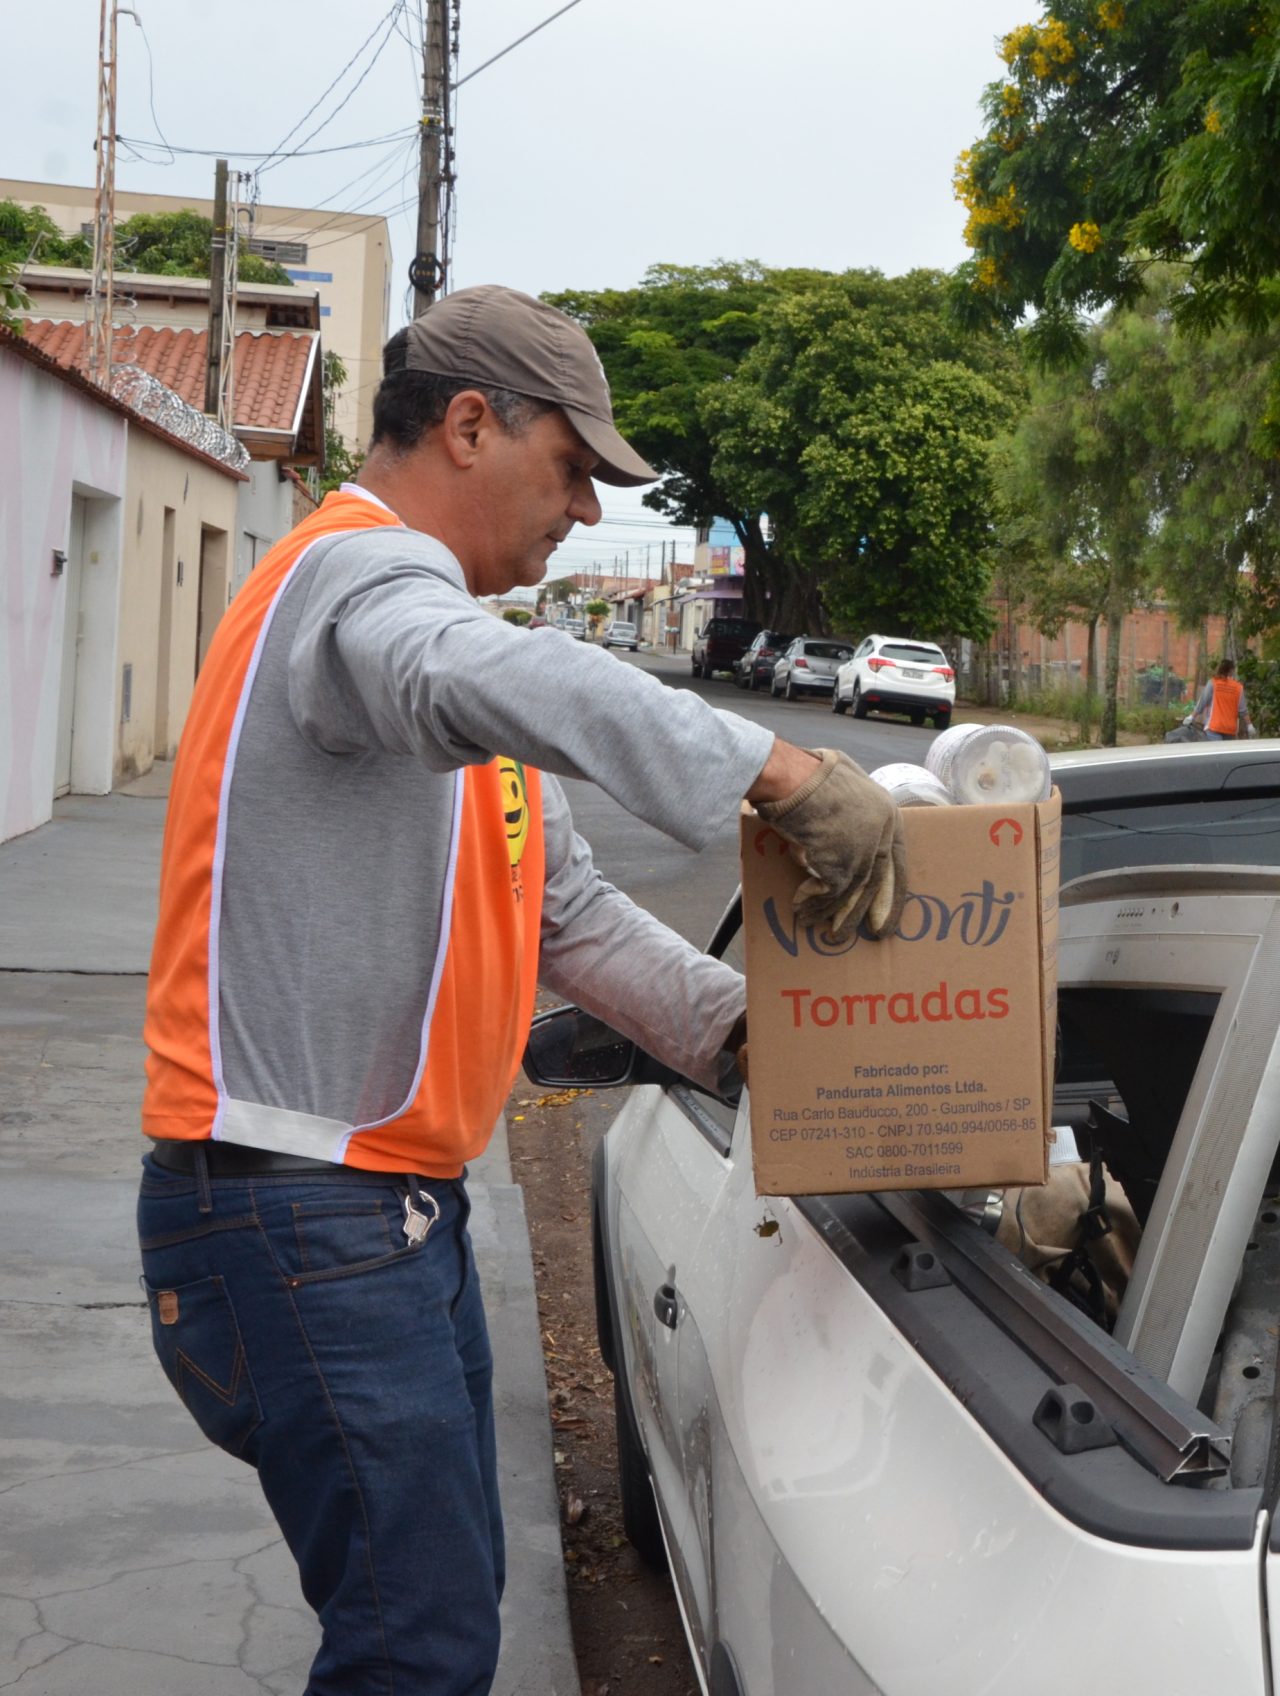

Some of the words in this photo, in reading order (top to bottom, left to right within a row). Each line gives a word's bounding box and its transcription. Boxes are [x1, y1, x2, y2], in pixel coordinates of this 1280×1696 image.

[763, 880, 1015, 957] Vonti
[780, 981, 1010, 1028] Torradas
[854, 1063, 919, 1078] Fabricado
[923, 1063, 948, 1077] por:
[816, 1085, 883, 1100] Pandurata
[886, 1082, 951, 1097] Alimentos
[955, 1080, 988, 1094] Ltda.
[773, 1108, 799, 1121] Rua
[801, 1106, 835, 1120] Carlo
[838, 1104, 899, 1119] Bauducco,
[906, 1103, 928, 1117] 200
[940, 1099, 1001, 1114] Guarulhos
[1013, 1097, 1031, 1111] SP
[769, 1128, 797, 1142] CEP
[801, 1125, 866, 1140] 07241-310
[877, 1123, 913, 1138] CNPJ
[846, 1145, 873, 1159] SAC
[849, 1164, 901, 1179] Indústria
[904, 1162, 961, 1177] Brasileira
